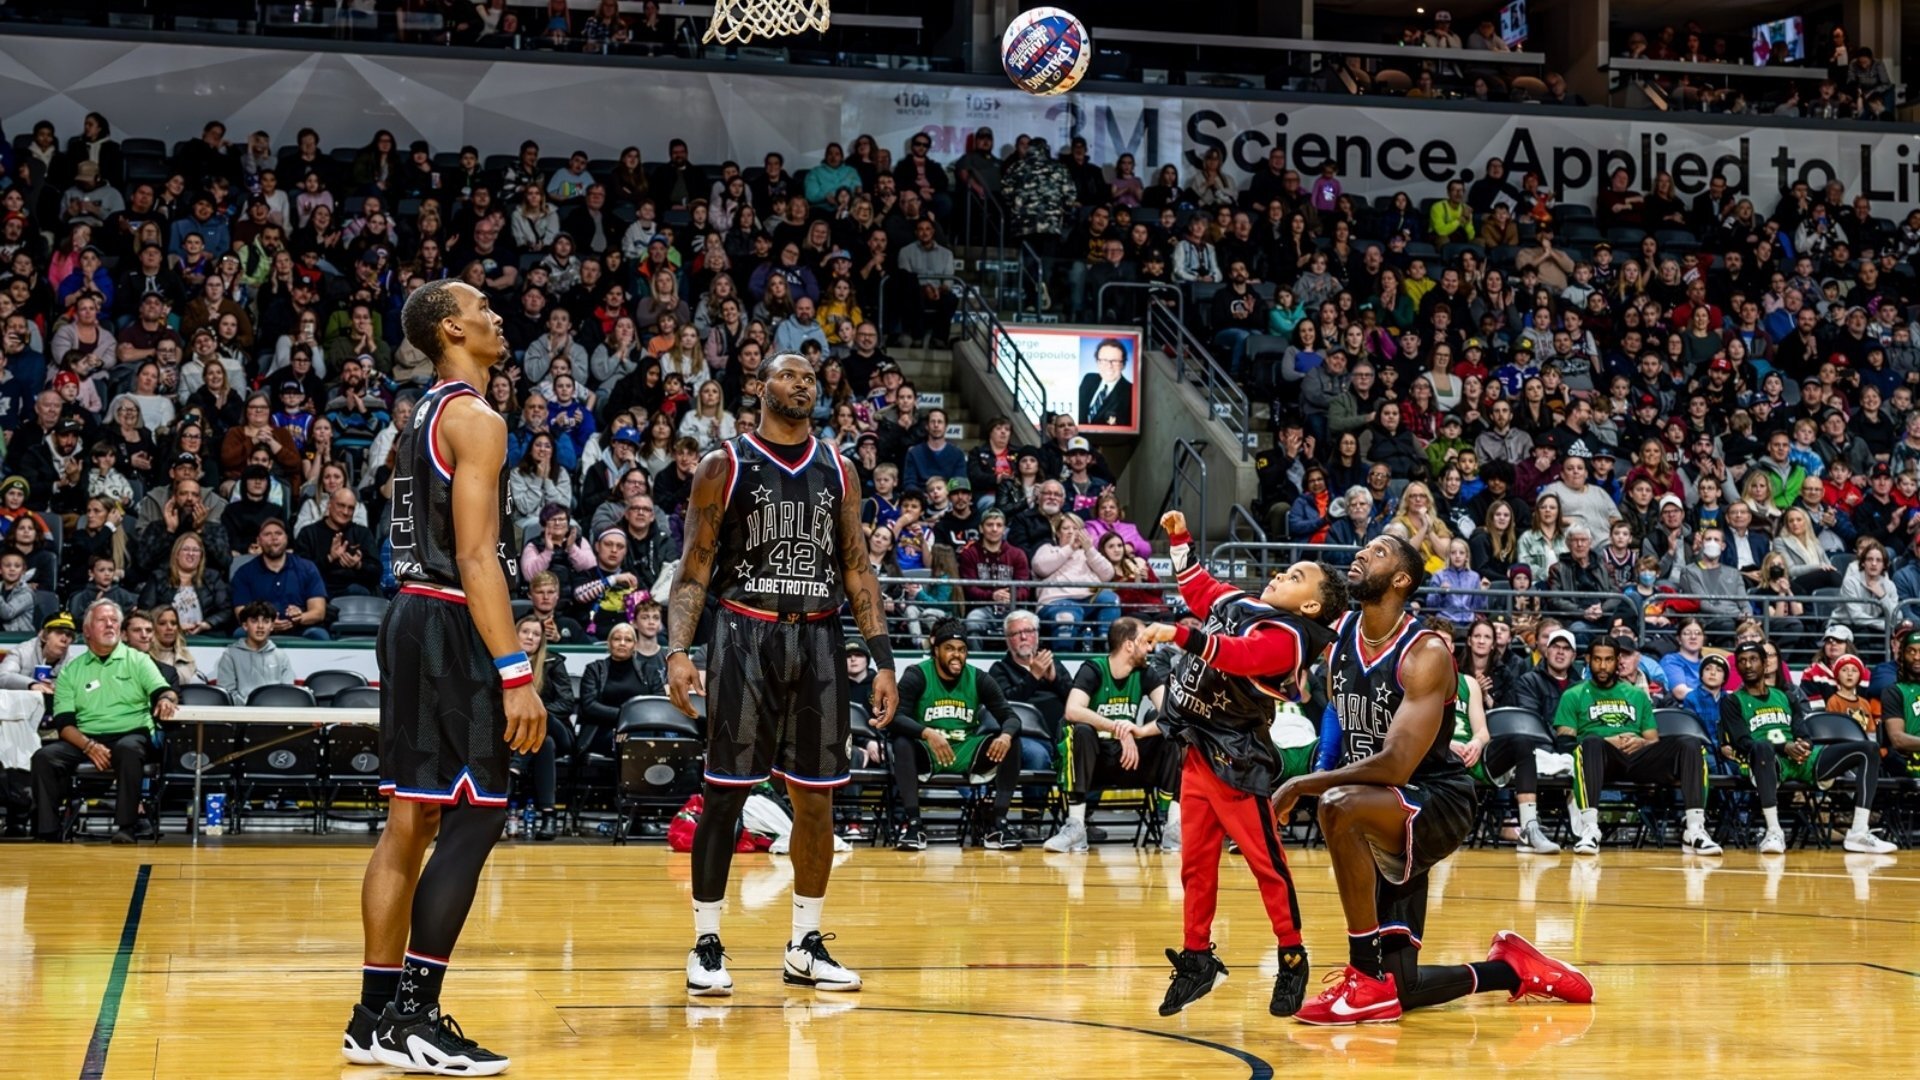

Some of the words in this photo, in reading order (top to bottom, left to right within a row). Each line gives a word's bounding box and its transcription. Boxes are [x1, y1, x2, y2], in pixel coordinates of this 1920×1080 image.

[1016, 34, 1050, 70] HARLEM
[1025, 41, 1074, 90] SPALDING
[1184, 109, 1475, 184] Science.
[1502, 127, 1750, 202] Applied
[1771, 146, 1837, 192] to
[1001, 350, 1077, 361] Gergopoulos
[769, 540, 817, 578] 42
[744, 577, 830, 598] GLOBETROTTERS
[924, 705, 974, 723] GENERALS
